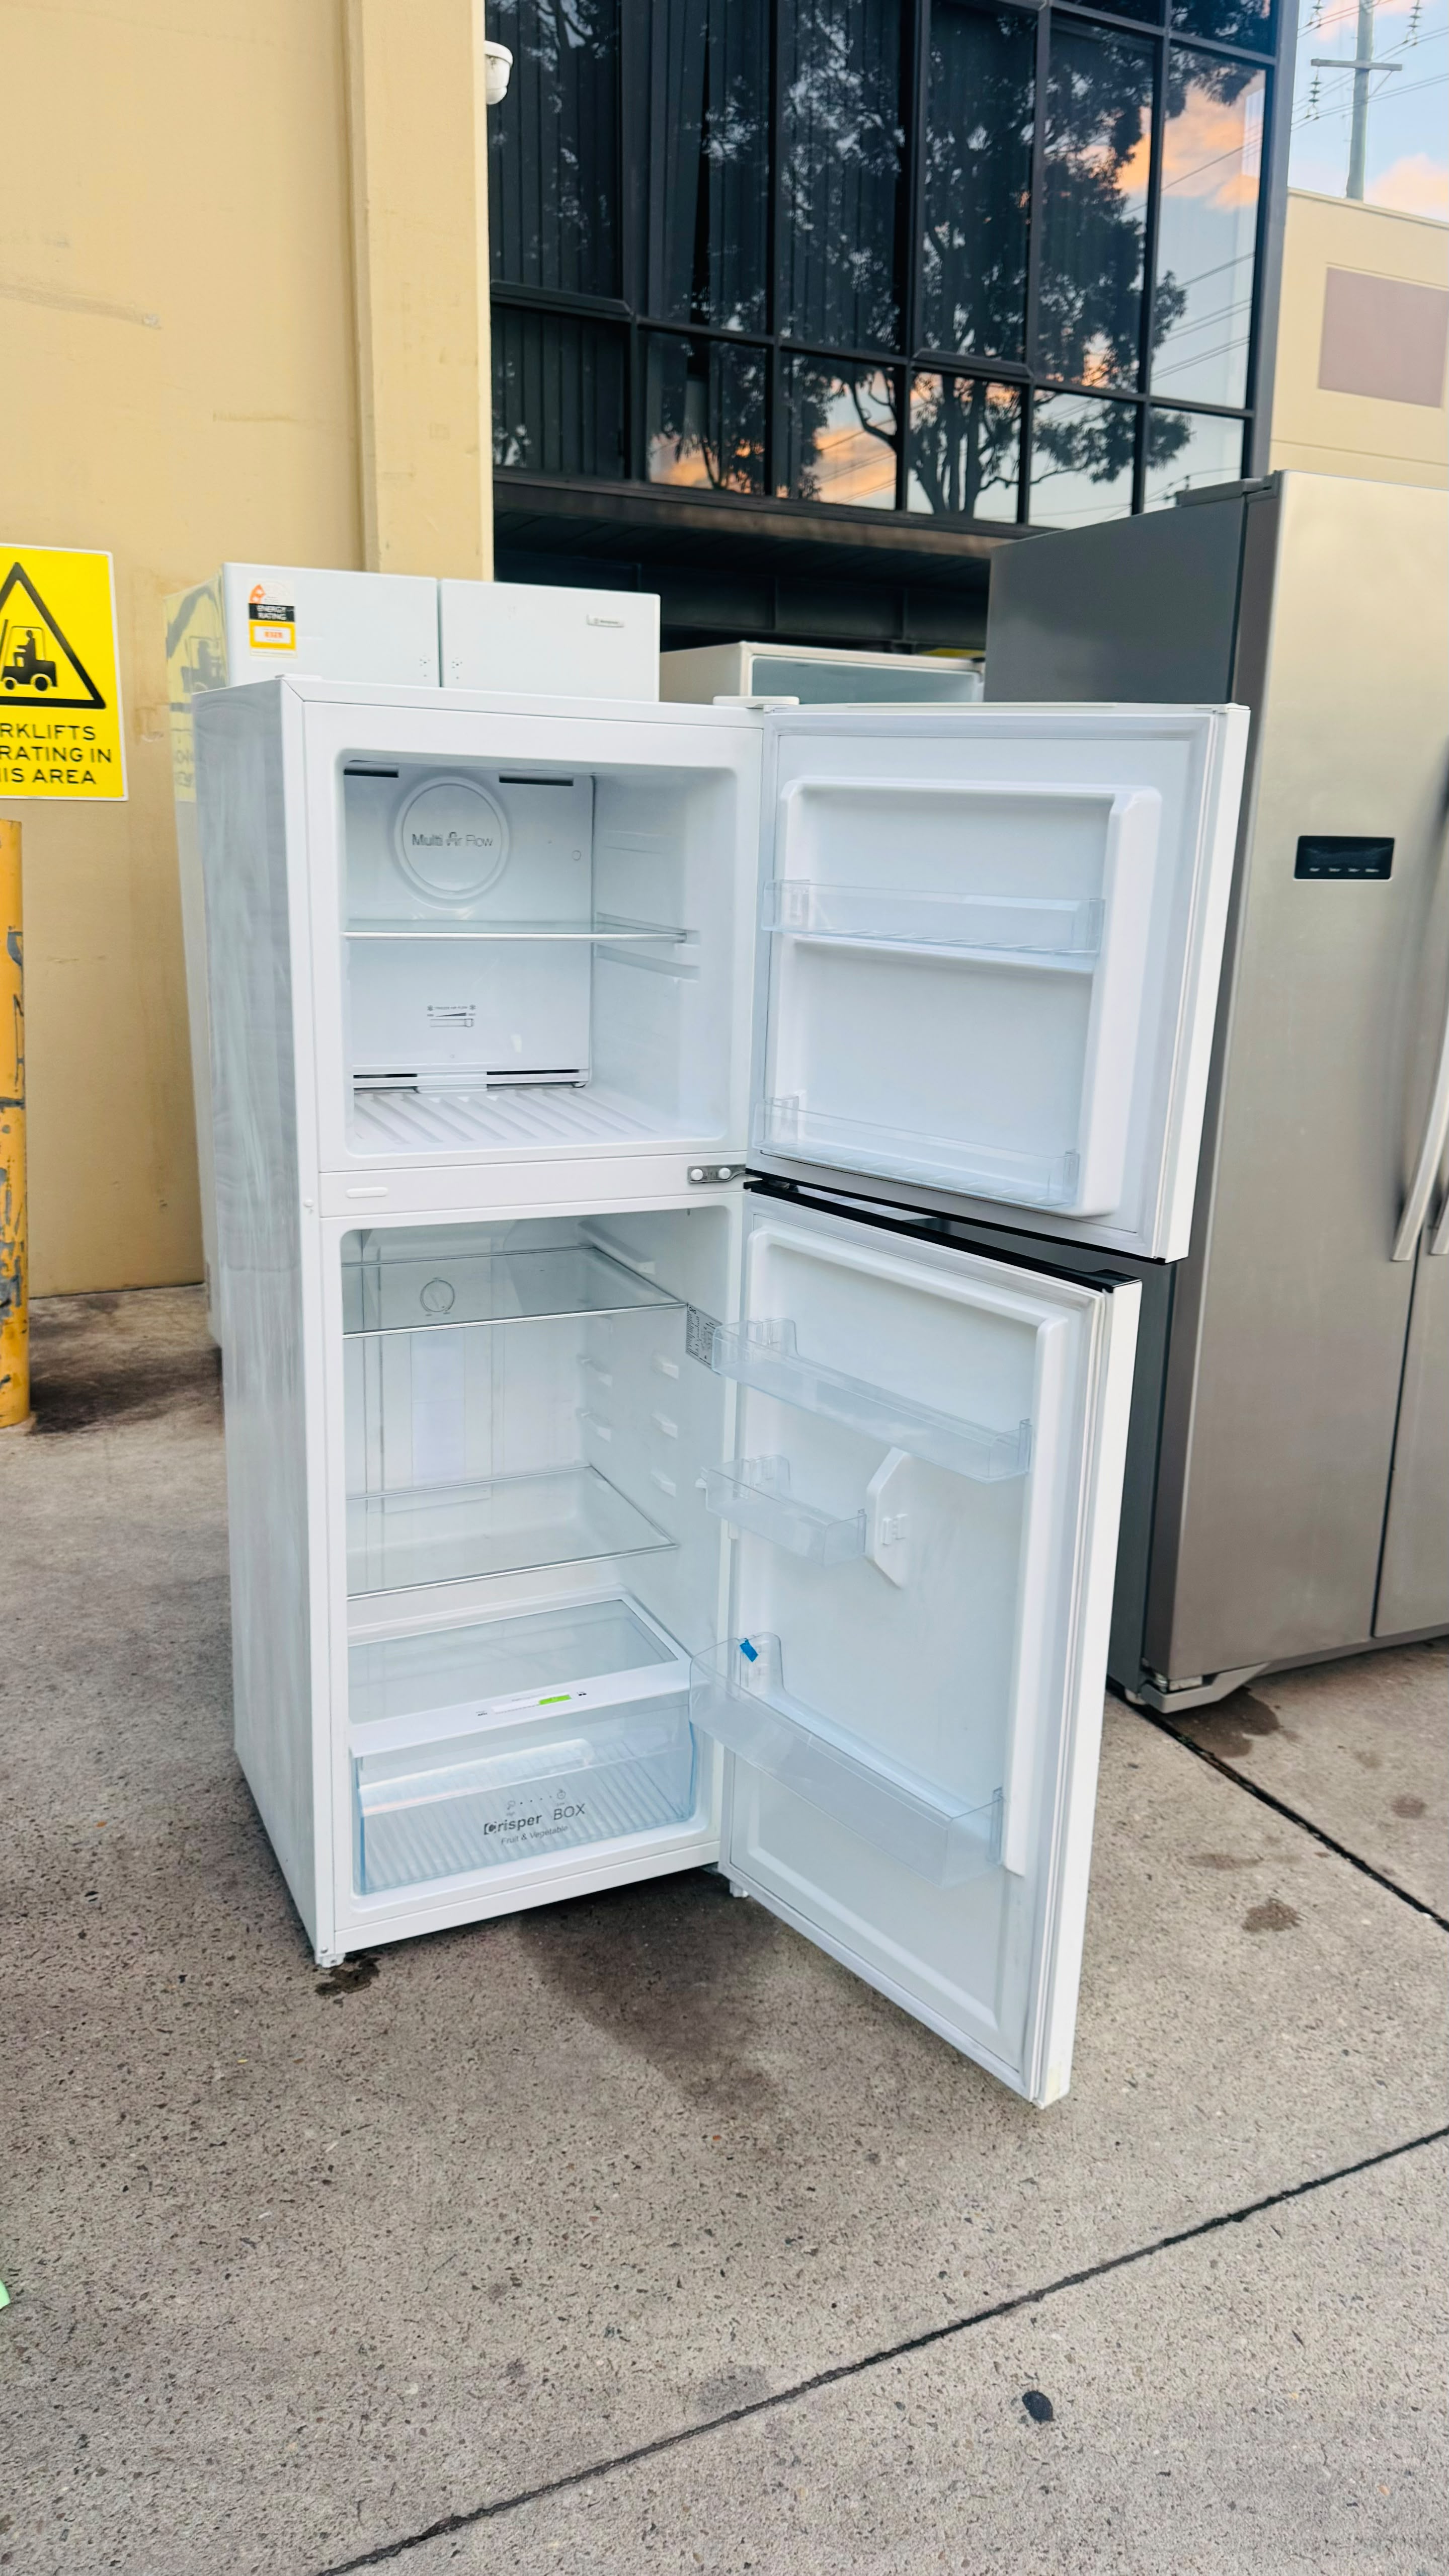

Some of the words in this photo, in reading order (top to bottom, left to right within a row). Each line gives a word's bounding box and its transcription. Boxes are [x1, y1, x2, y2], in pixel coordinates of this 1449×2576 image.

[91, 748, 111, 763] IN
[0, 767, 24, 783] IS
[32, 769, 97, 784] AREA
[412, 833, 443, 846] Multi
[484, 1814, 542, 1835] Crisper
[553, 1803, 586, 1820] BOX
[501, 1835, 519, 1844] Fruit
[530, 1825, 569, 1839] Vegetable
